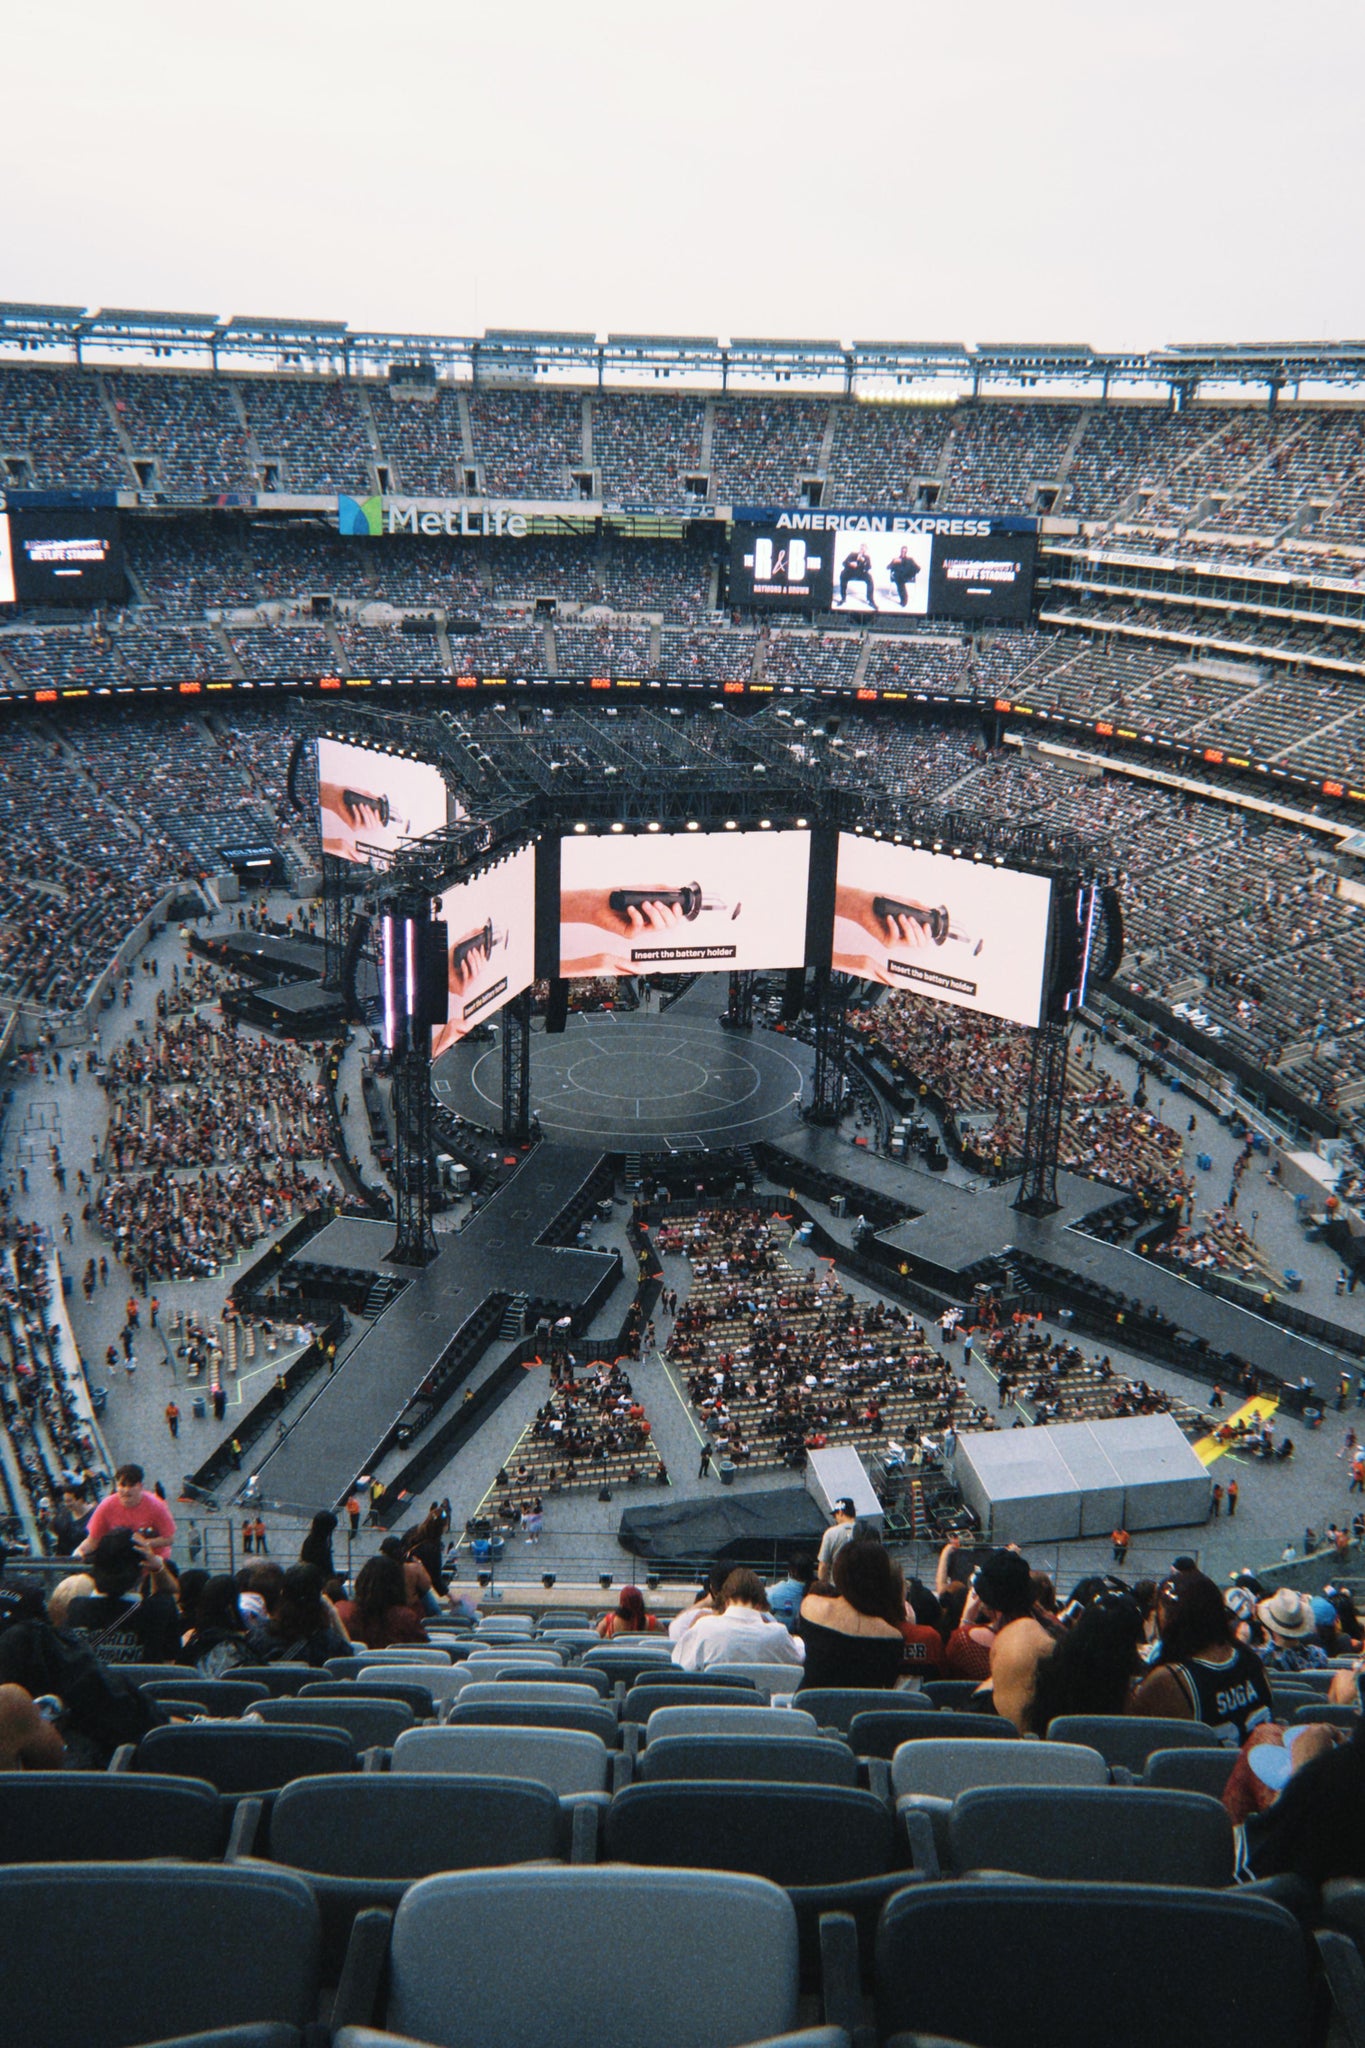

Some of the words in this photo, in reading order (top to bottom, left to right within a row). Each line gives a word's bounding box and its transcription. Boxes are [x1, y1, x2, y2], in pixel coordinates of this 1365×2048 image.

[388, 503, 528, 538] MetLife
[776, 512, 887, 532] AMERICAN
[892, 517, 992, 537] EXPRESS
[634, 951, 659, 960] Insert
[660, 950, 675, 959] the
[675, 949, 705, 958] battery
[706, 948, 734, 957] holder
[890, 962, 911, 975] Insert
[911, 968, 924, 979] the
[924, 972, 950, 988] battery
[950, 979, 975, 993] holder
[904, 1643, 927, 1660] ER
[1216, 1679, 1258, 1715] SUGA
